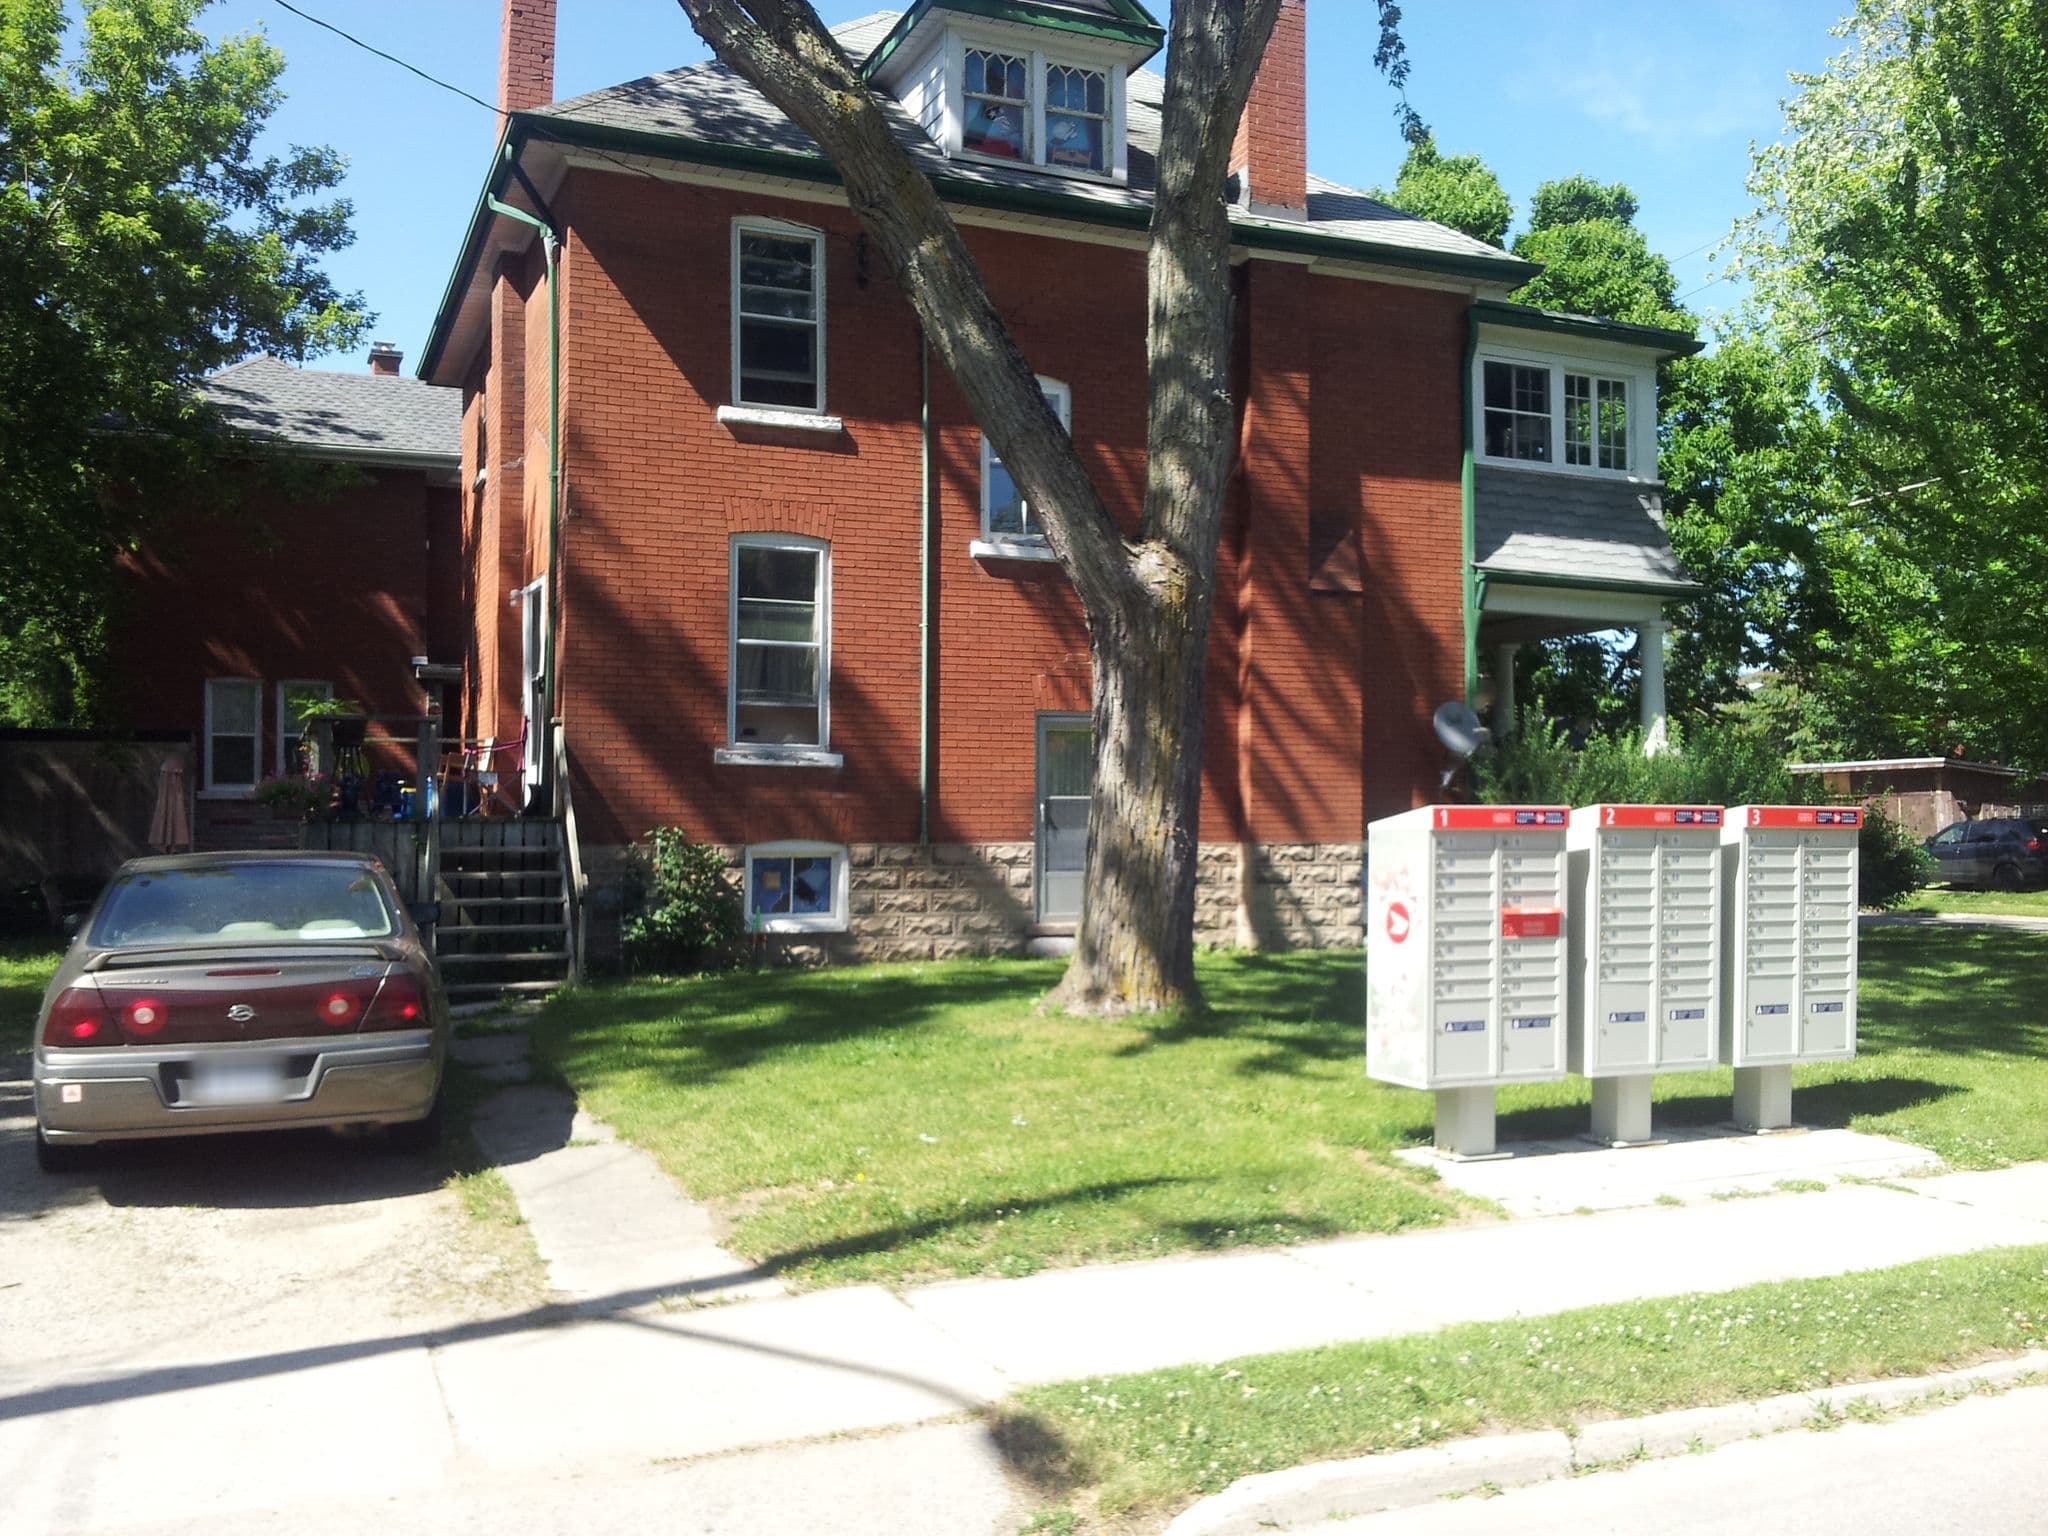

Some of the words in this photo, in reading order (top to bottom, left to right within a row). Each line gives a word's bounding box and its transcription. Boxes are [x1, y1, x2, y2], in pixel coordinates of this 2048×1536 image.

[1440, 809, 1448, 827] 1
[1606, 808, 1616, 825] 2
[1752, 809, 1760, 825] 3
[1611, 1012, 1617, 1022] A
[1756, 1005, 1763, 1014] A
